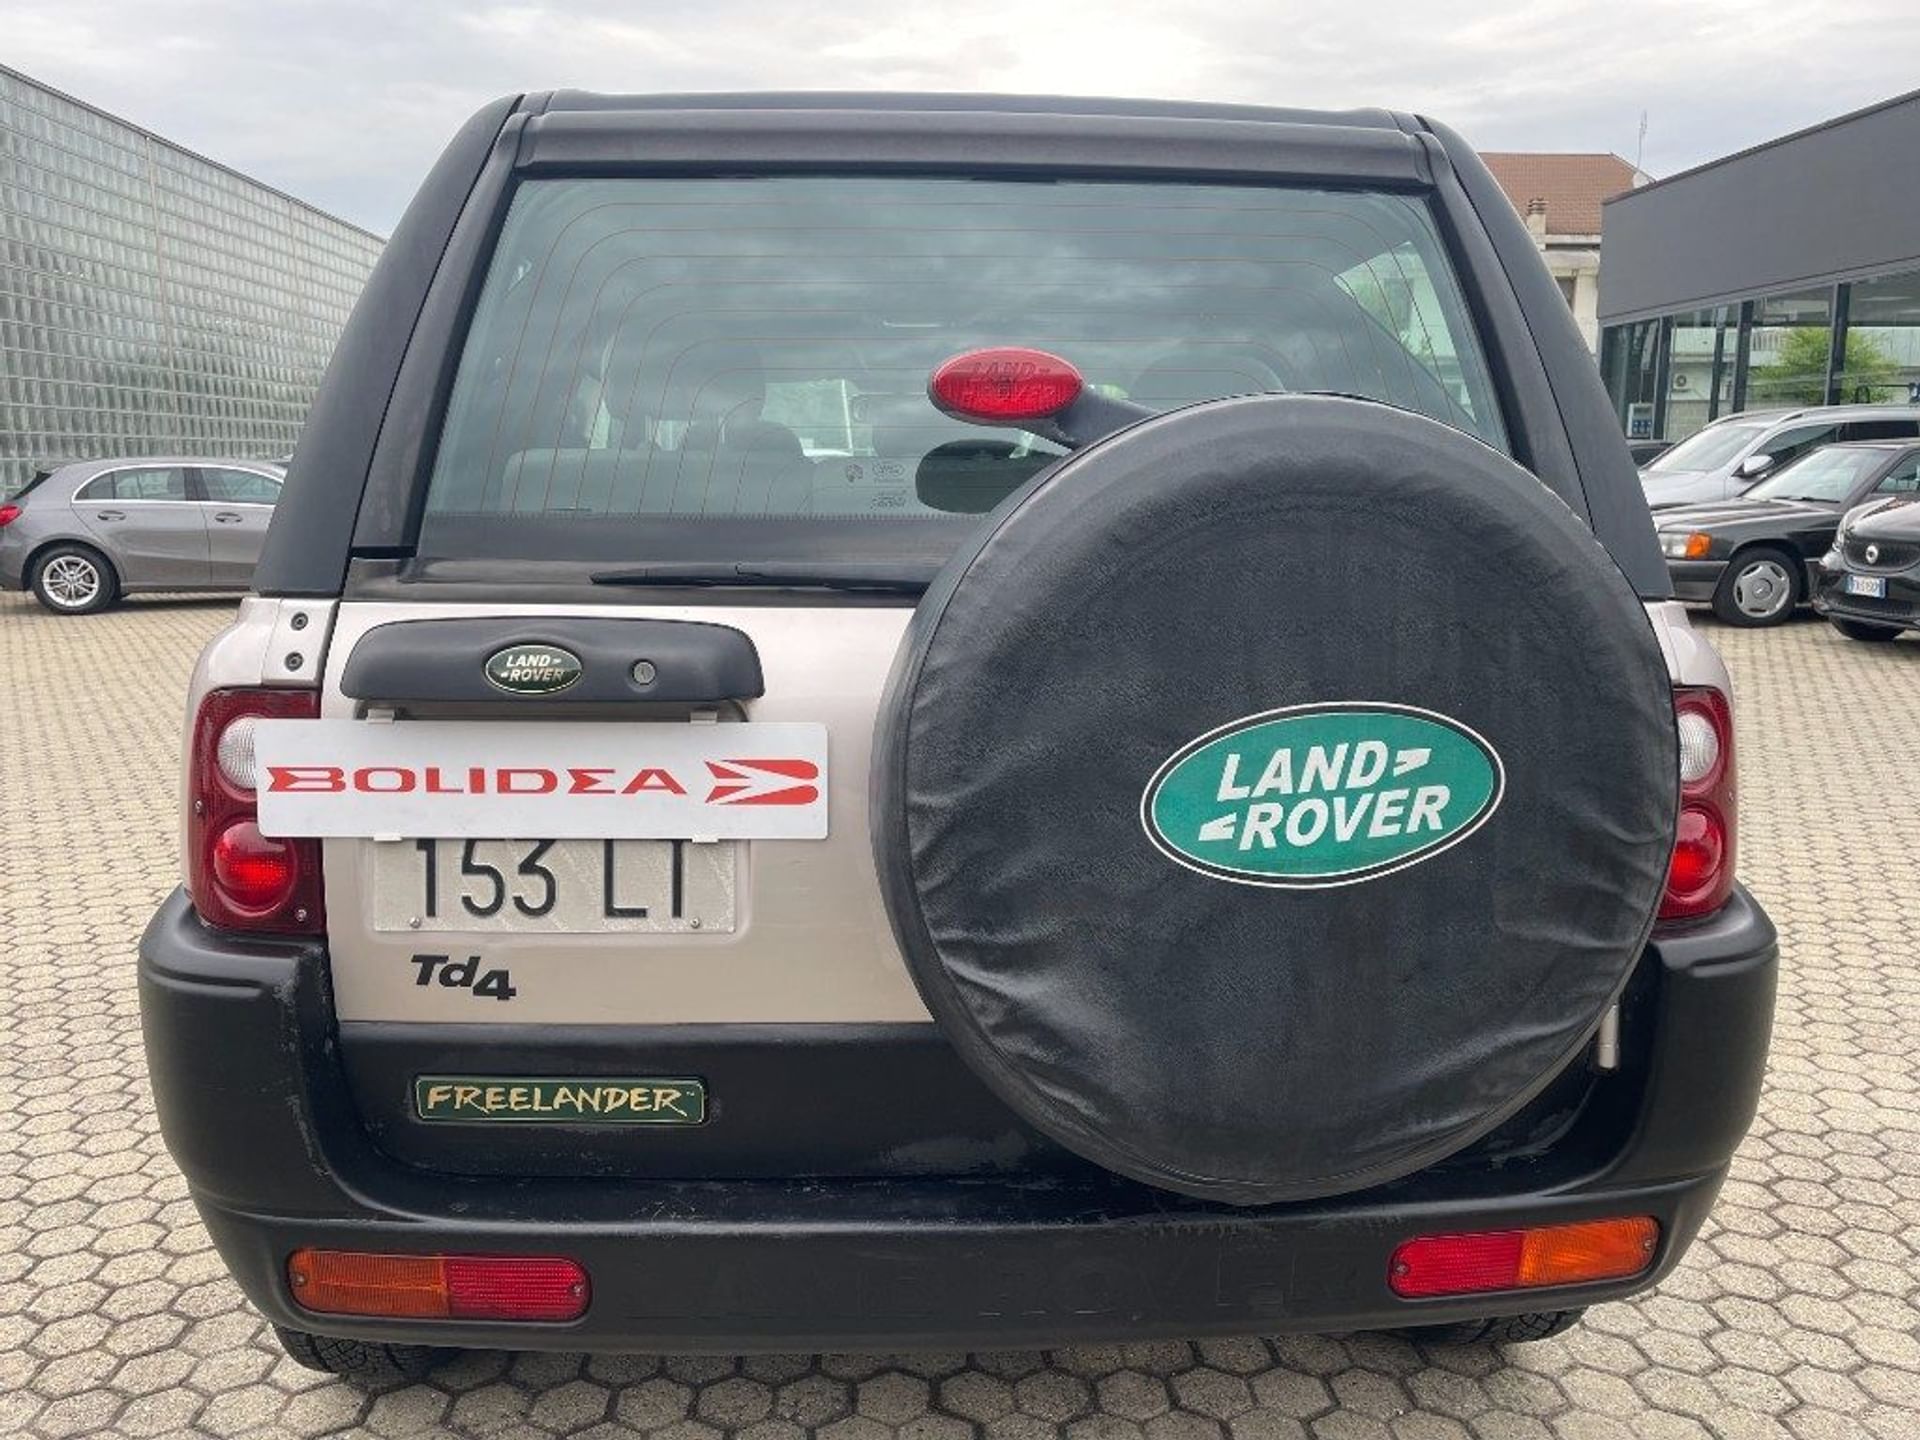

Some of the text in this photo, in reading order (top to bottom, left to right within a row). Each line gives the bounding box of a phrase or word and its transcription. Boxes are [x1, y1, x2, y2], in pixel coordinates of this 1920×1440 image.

[506, 655, 551, 667] LAND
[509, 668, 564, 682] ROVER
[1217, 740, 1389, 801] LAND
[1239, 785, 1451, 851] ROVER
[411, 955, 517, 1001] Td4
[427, 1085, 688, 1117] FREELANDER
